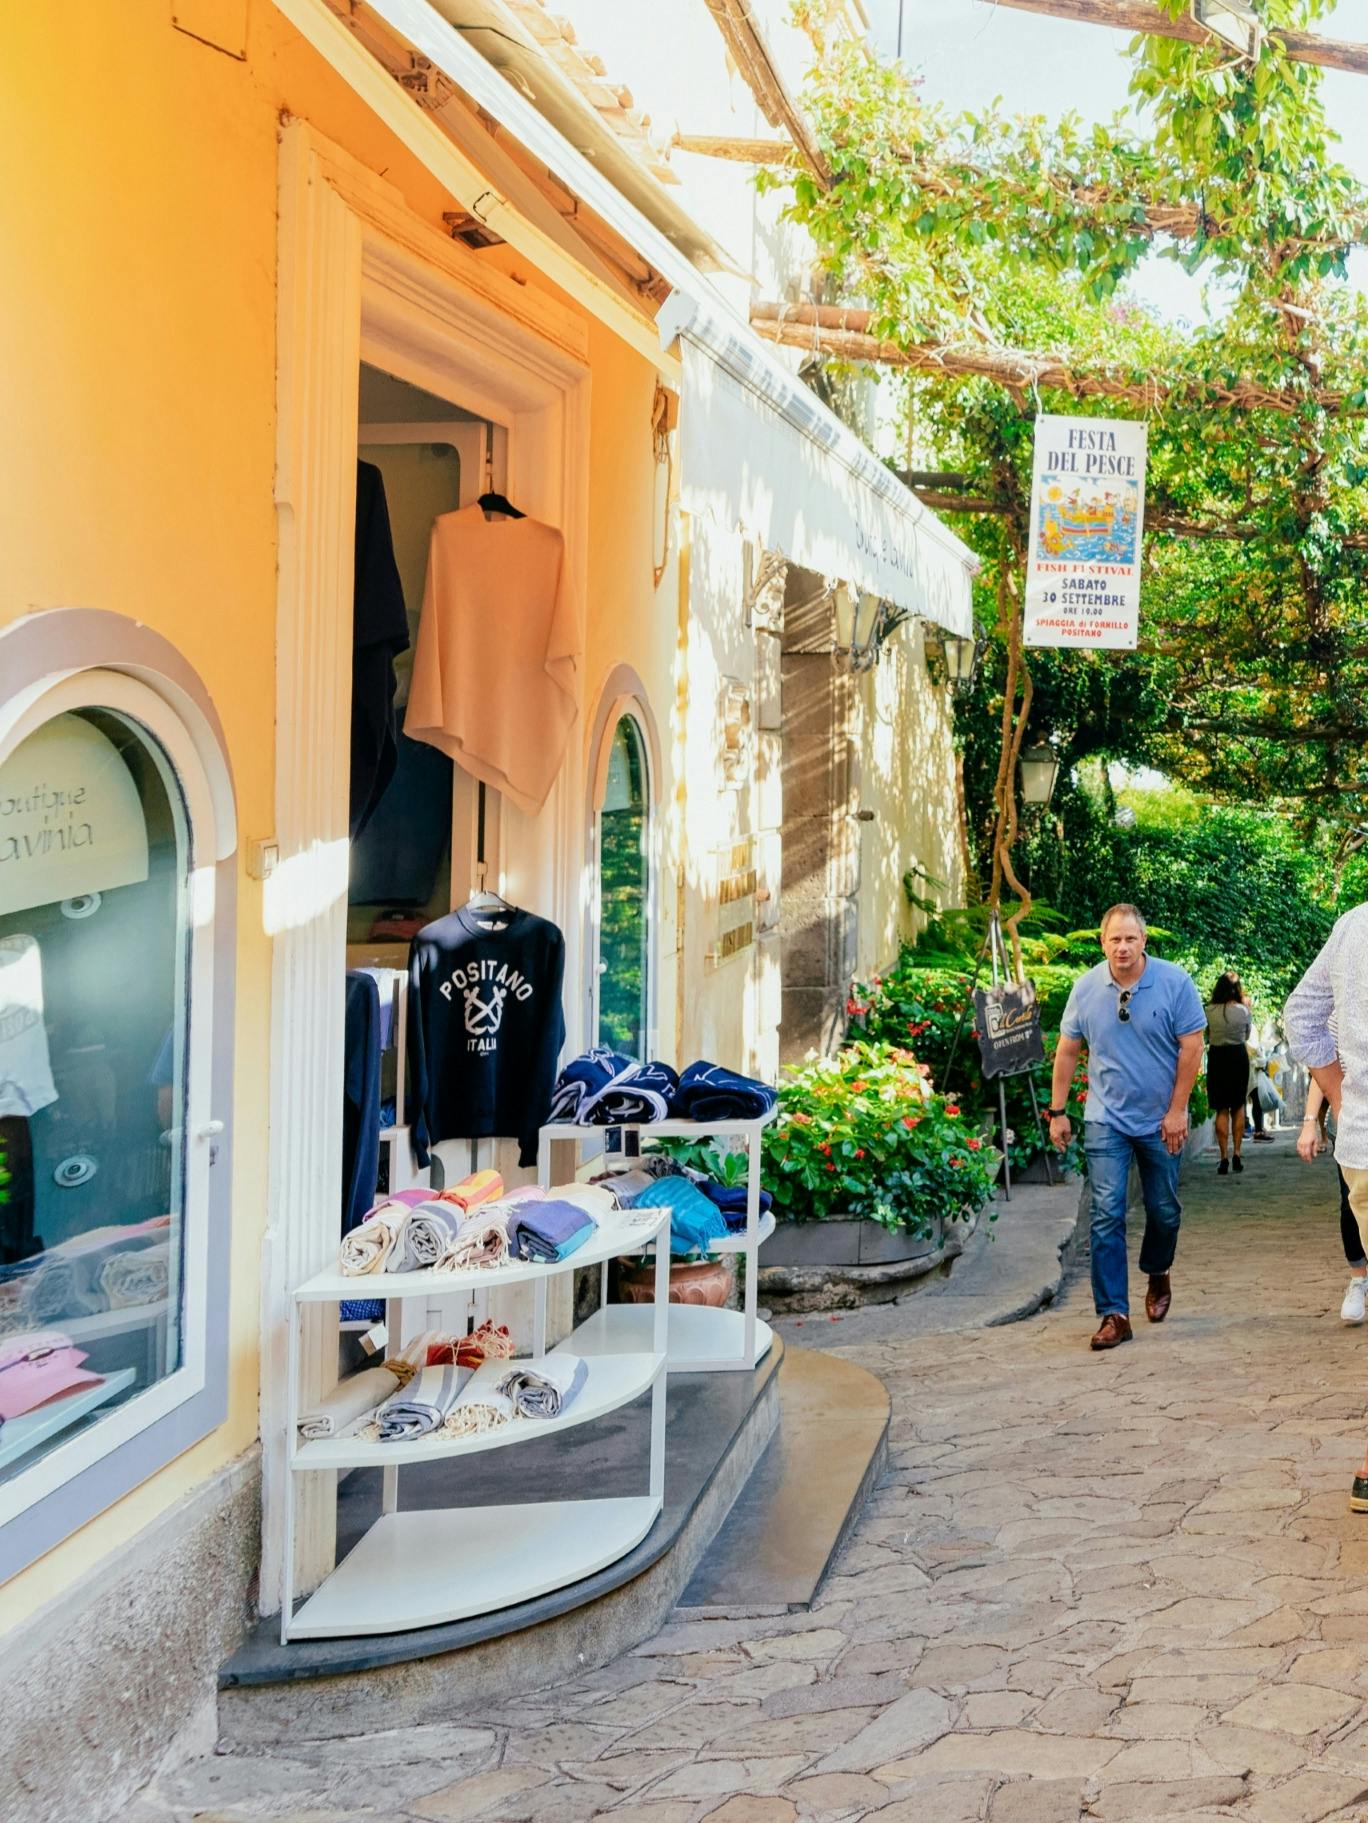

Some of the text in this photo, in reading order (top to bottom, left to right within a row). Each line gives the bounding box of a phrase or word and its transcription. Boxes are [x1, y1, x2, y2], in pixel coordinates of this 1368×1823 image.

[1068, 428, 1117, 452] FESTA
[1047, 451, 1136, 477] DEL PESCE
[1035, 562, 1068, 573] FISH
[1061, 577, 1107, 591] SABATO
[1042, 591, 1126, 607] 30 SETTEMBRE
[1063, 606, 1077, 615] ORE
[1036, 618, 1076, 628] SPIAGGIA
[1089, 620, 1129, 630] FORNILLO
[1061, 628, 1102, 638] POSITANO
[0, 782, 88, 818] outique
[0, 810, 94, 862] avinia
[439, 960, 533, 1001] POSITANO
